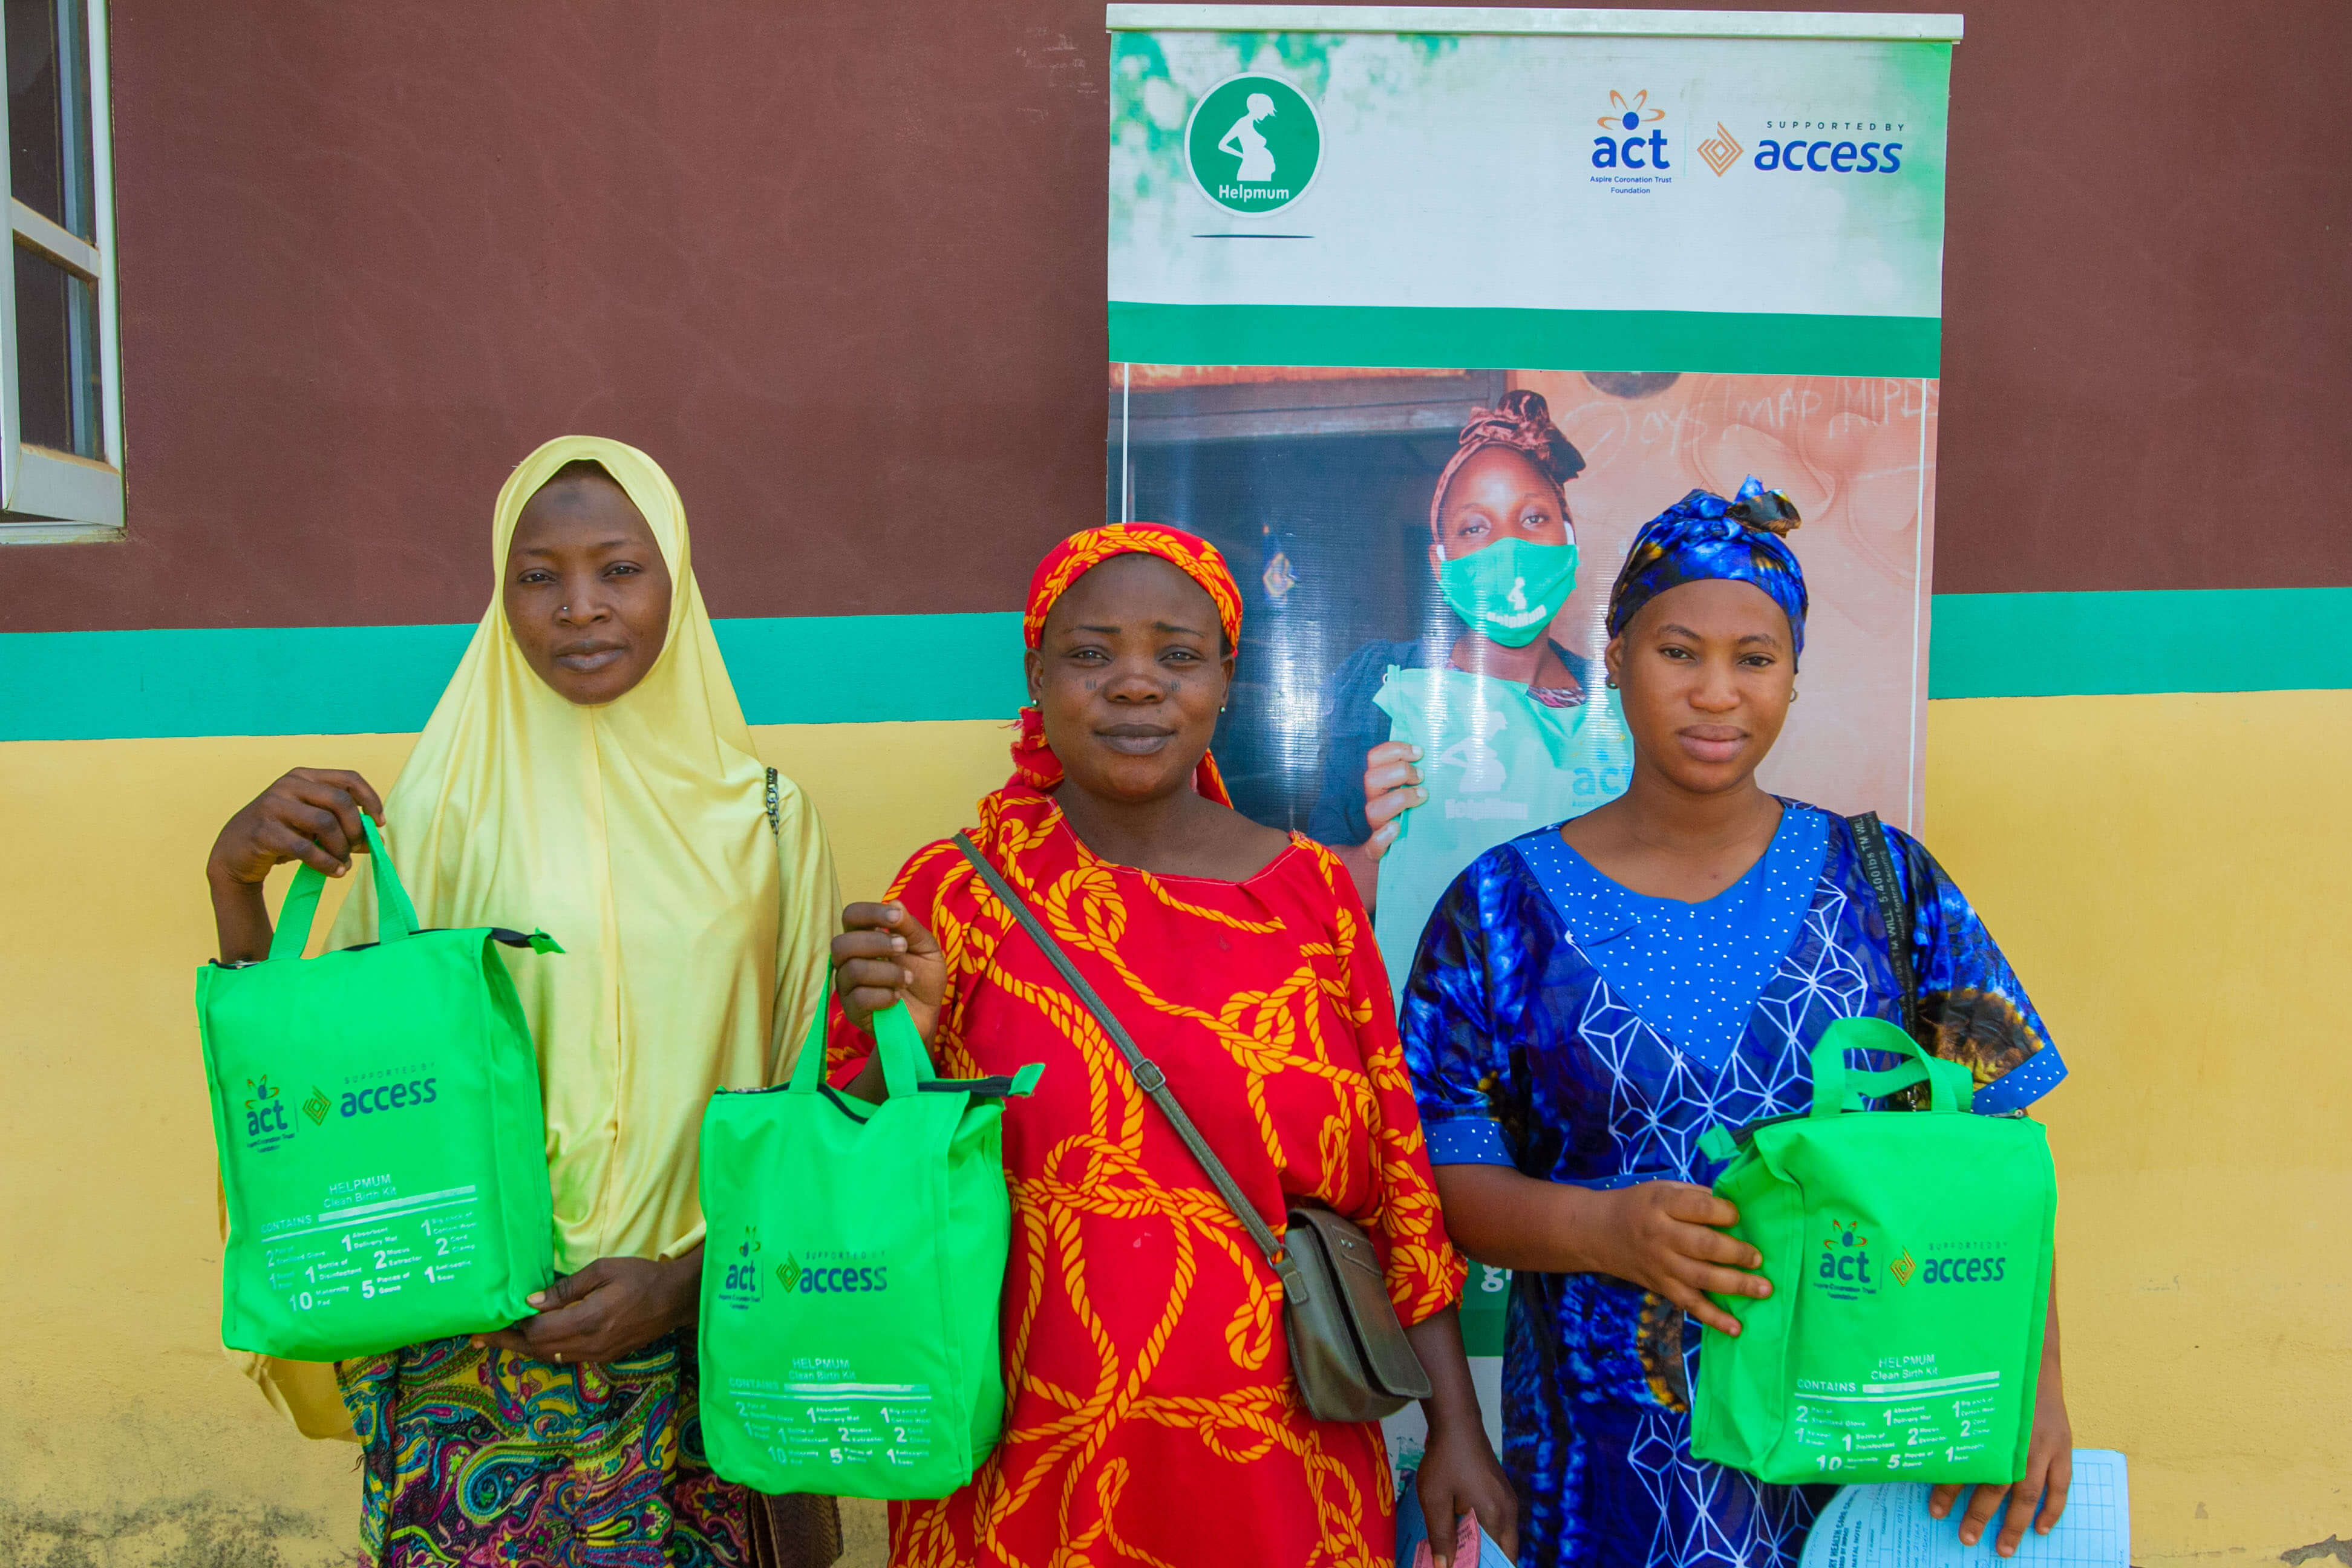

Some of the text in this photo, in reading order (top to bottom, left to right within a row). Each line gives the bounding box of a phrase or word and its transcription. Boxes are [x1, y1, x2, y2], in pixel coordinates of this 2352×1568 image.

[1767, 120, 1905, 131] SUPPORTED BY
[1592, 129, 1670, 169] act
[1754, 139, 1903, 174] access
[1590, 175, 1672, 185] Aspire Coronation Trust
[1218, 184, 1290, 203] Helpmum
[1610, 186, 1651, 194] Foundation
[341, 1077, 436, 1117] access
[246, 1100, 288, 1136] act
[329, 1174, 391, 1195] HELPMUM
[324, 1196, 352, 1209] Clean
[261, 1215, 312, 1233] CONTAINS
[421, 1219, 431, 1236] 1
[341, 1234, 351, 1252] 1
[436, 1238, 449, 1256] 2
[266, 1250, 275, 1267] 2
[374, 1250, 387, 1269] 2
[1820, 1251, 1871, 1283] act
[305, 1266, 315, 1284] 1
[424, 1266, 435, 1284] 1
[725, 1259, 756, 1292] act
[1923, 1257, 2006, 1284] access
[362, 1279, 374, 1298] 5
[799, 1266, 888, 1294] access
[290, 1292, 313, 1312] 10
[792, 1358, 851, 1370] HELPMUM
[1879, 1354, 1935, 1368] HELPMUM
[1871, 1370, 1900, 1381] Clean
[1797, 1379, 1857, 1393] CONTAINS
[736, 1401, 748, 1417] 2
[806, 1407, 816, 1423] 1
[880, 1407, 890, 1423] 1
[1795, 1405, 1809, 1423] 2
[1952, 1400, 1960, 1418] 1
[1883, 1410, 1892, 1426] 1
[778, 1428, 787, 1444] 1
[838, 1426, 851, 1442] 2
[894, 1426, 907, 1443] 2
[1795, 1428, 1805, 1443] 1
[1907, 1428, 1919, 1446] 2
[1960, 1420, 1971, 1437] 2
[1842, 1434, 1852, 1452] 1
[768, 1446, 787, 1465] 10
[829, 1448, 843, 1465] 5
[886, 1448, 896, 1465] 1
[1817, 1455, 1843, 1471] 10
[1887, 1454, 1901, 1469] 5
[1945, 1446, 1955, 1463] 1
